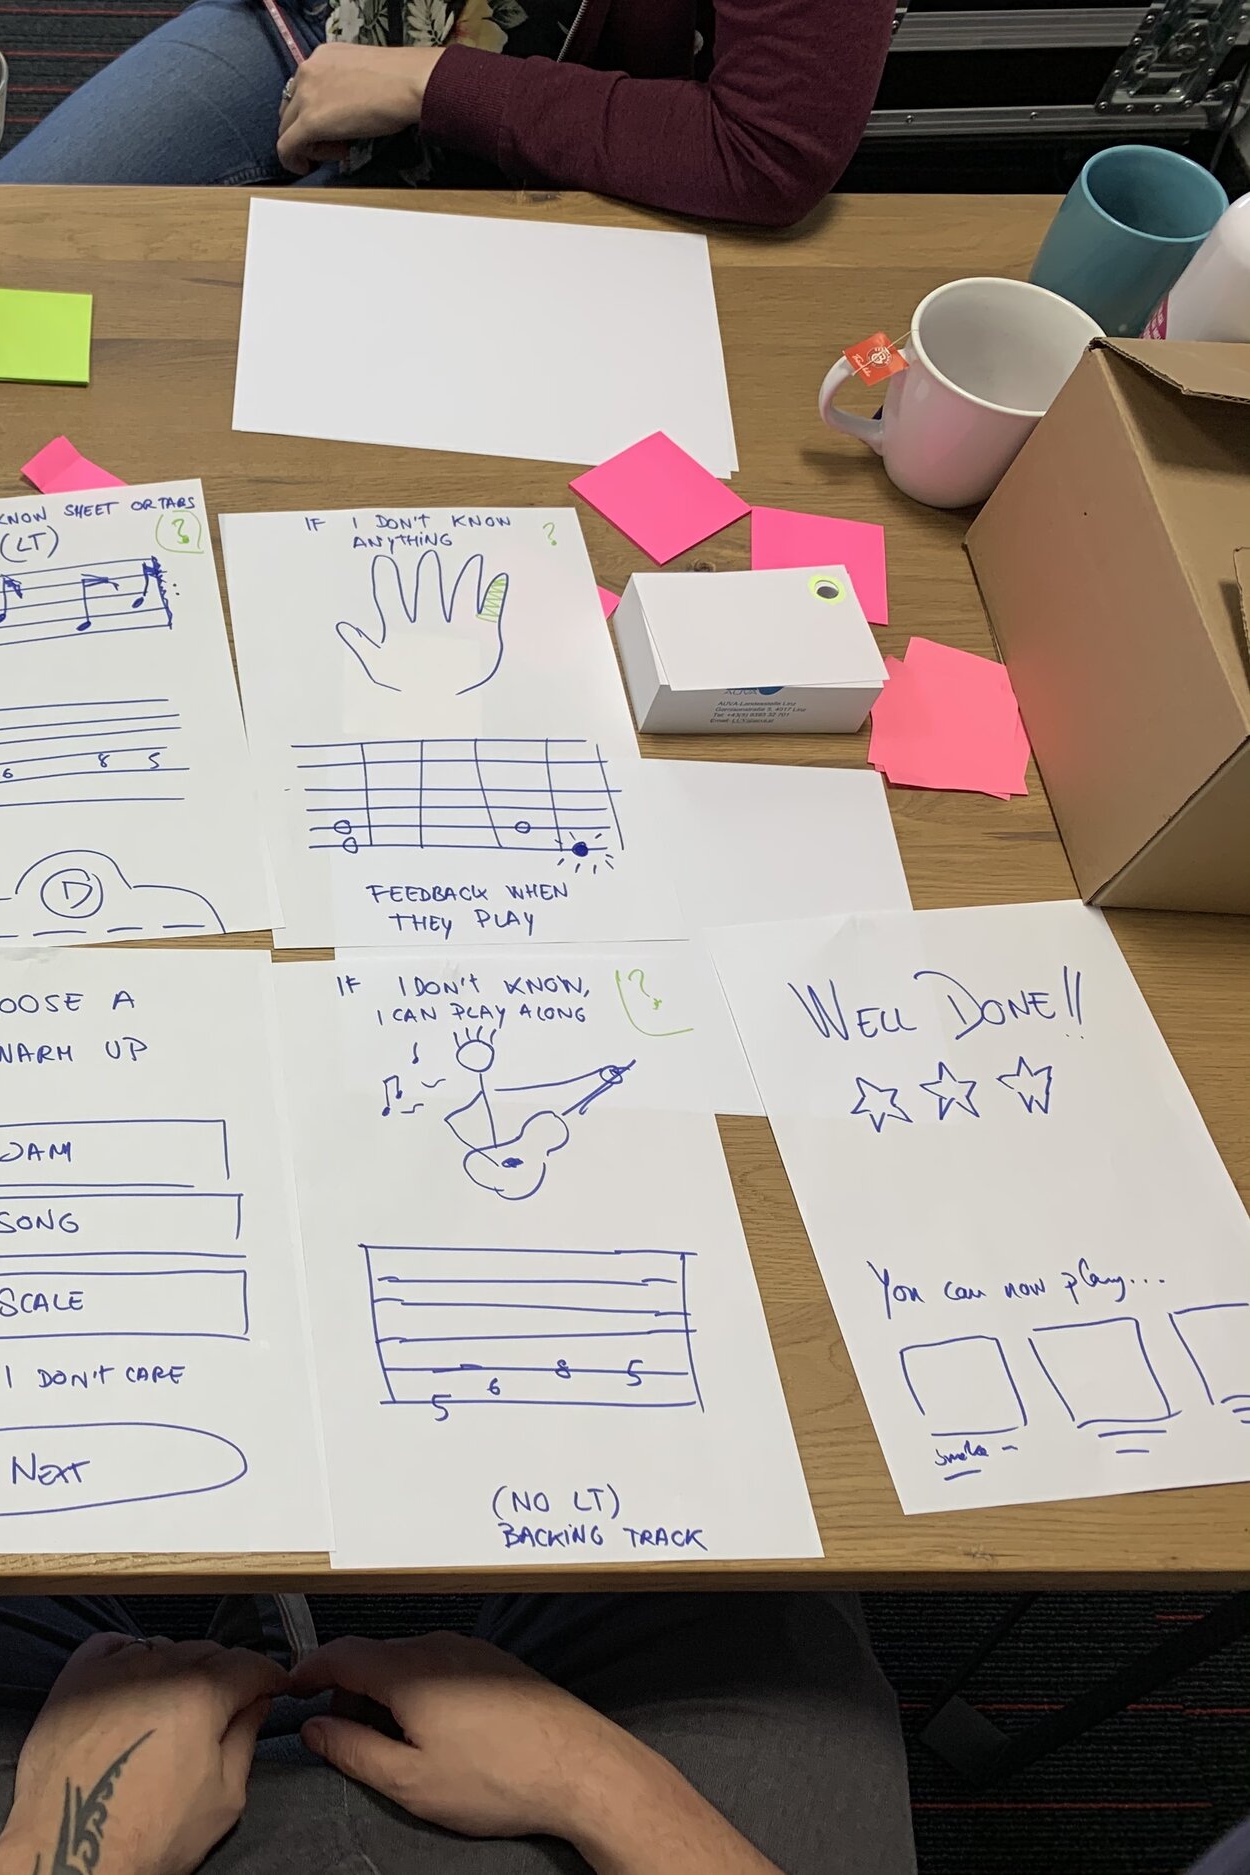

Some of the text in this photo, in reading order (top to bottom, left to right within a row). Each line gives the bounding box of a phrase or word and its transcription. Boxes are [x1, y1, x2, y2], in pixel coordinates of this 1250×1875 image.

[64, 502, 119, 518] SHEET
[305, 514, 510, 531] IF I DON'T KNOW
[543, 523, 557, 545] ?
[3, 767, 14, 779] 6
[366, 882, 567, 903] FEEDBACK WHEN
[388, 909, 533, 940] THEY PLAY
[337, 975, 361, 996] IF
[399, 976, 406, 996] I
[414, 973, 479, 996] DON'T
[112, 991, 134, 1010] A
[377, 1003, 585, 1029] I CAN PLAY ALONG
[105, 1037, 147, 1061] UP
[866, 1261, 925, 1319] You
[944, 1281, 986, 1300] can
[1004, 1278, 1045, 1298] now
[6, 1365, 185, 1388] I DON'T CARE
[623, 1527, 708, 1551] TRACK
